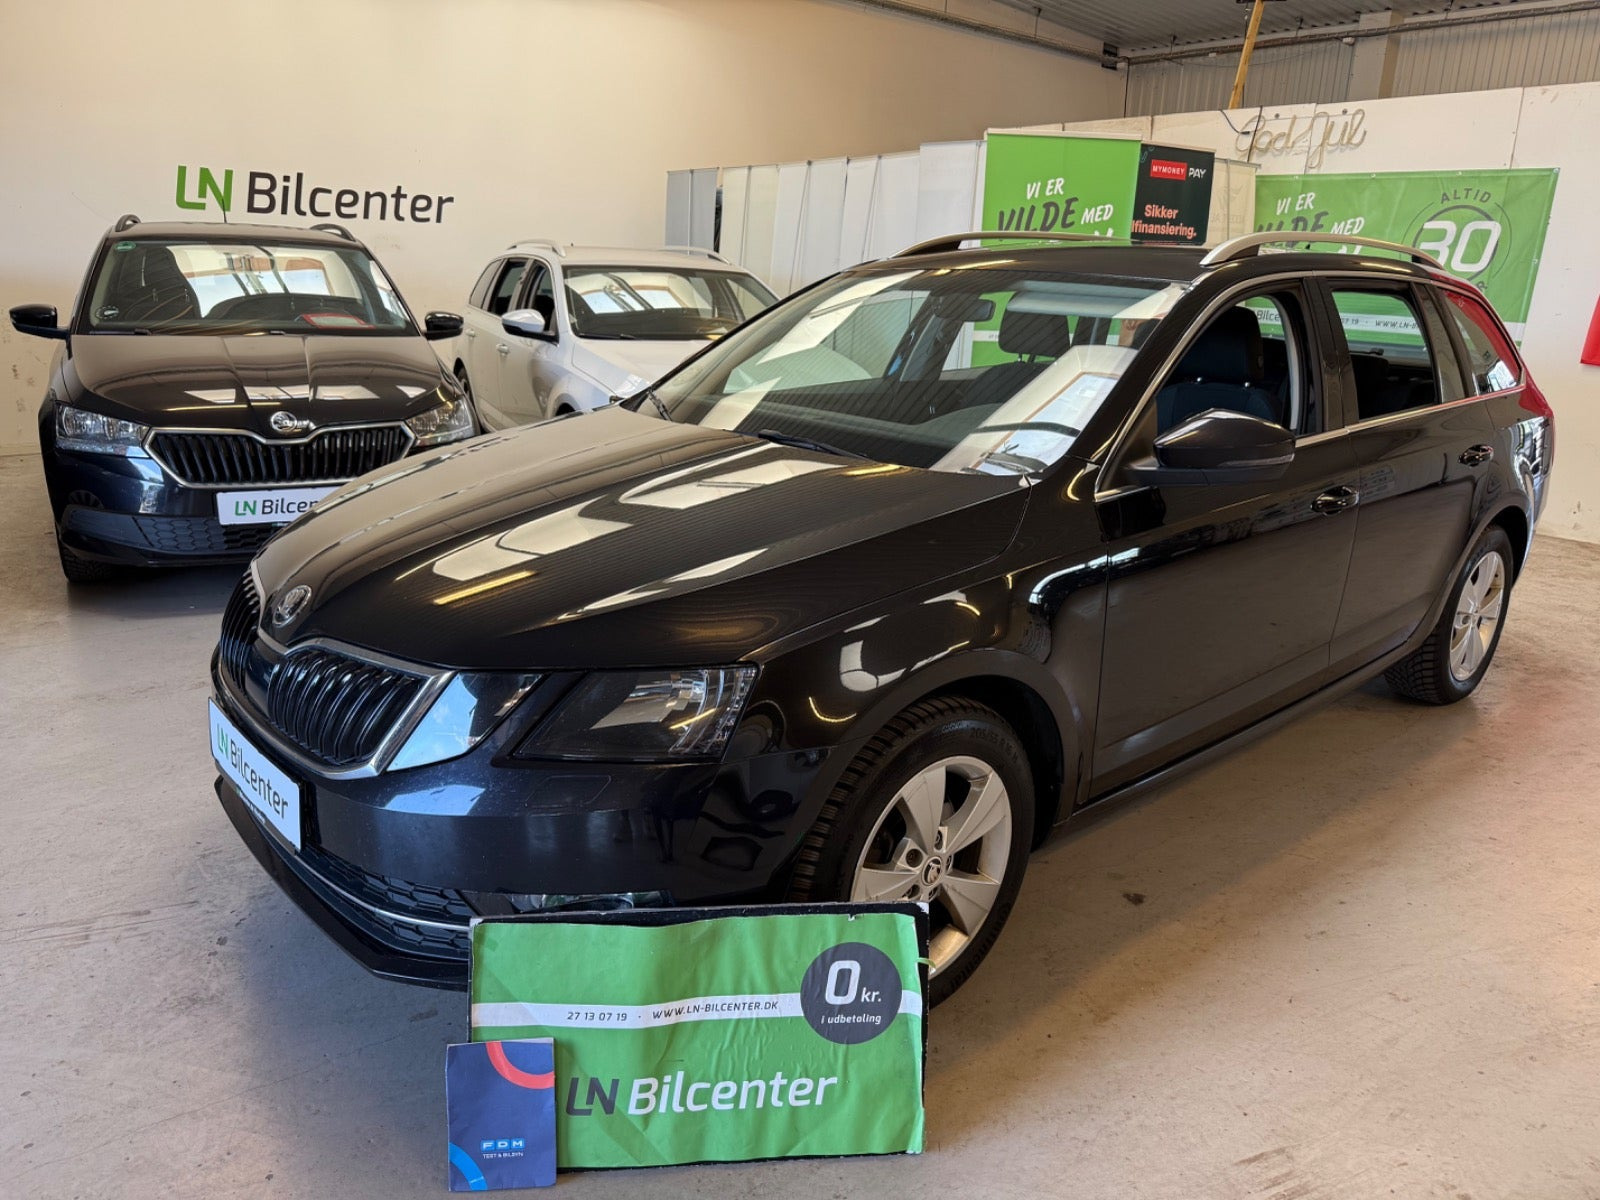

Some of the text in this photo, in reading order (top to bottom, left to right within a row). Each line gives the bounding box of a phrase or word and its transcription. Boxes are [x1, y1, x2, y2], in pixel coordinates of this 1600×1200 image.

[1151, 165, 1207, 179] MYMONEY PAY
[175, 165, 455, 224] LN Bilcenter
[1026, 177, 1065, 200] VI ER
[1440, 187, 1492, 204] ALTID
[998, 196, 1114, 233] VILDE MED
[1144, 204, 1179, 219] Sikker
[1276, 192, 1316, 216] VI ER
[1330, 216, 1365, 236] MED
[1420, 220, 1502, 272] 30
[234, 500, 257, 516] LN
[216, 723, 229, 760] LN
[230, 738, 289, 820] Bilcenter
[825, 959, 882, 1006] 0 kr.
[567, 1001, 779, 1022] 27 13 07 19 WWW.LN-BILCENTER.DK
[827, 1013, 882, 1025] udbetaling
[565, 1070, 838, 1117] LN Bilcenter
[481, 1139, 524, 1150] FDM
